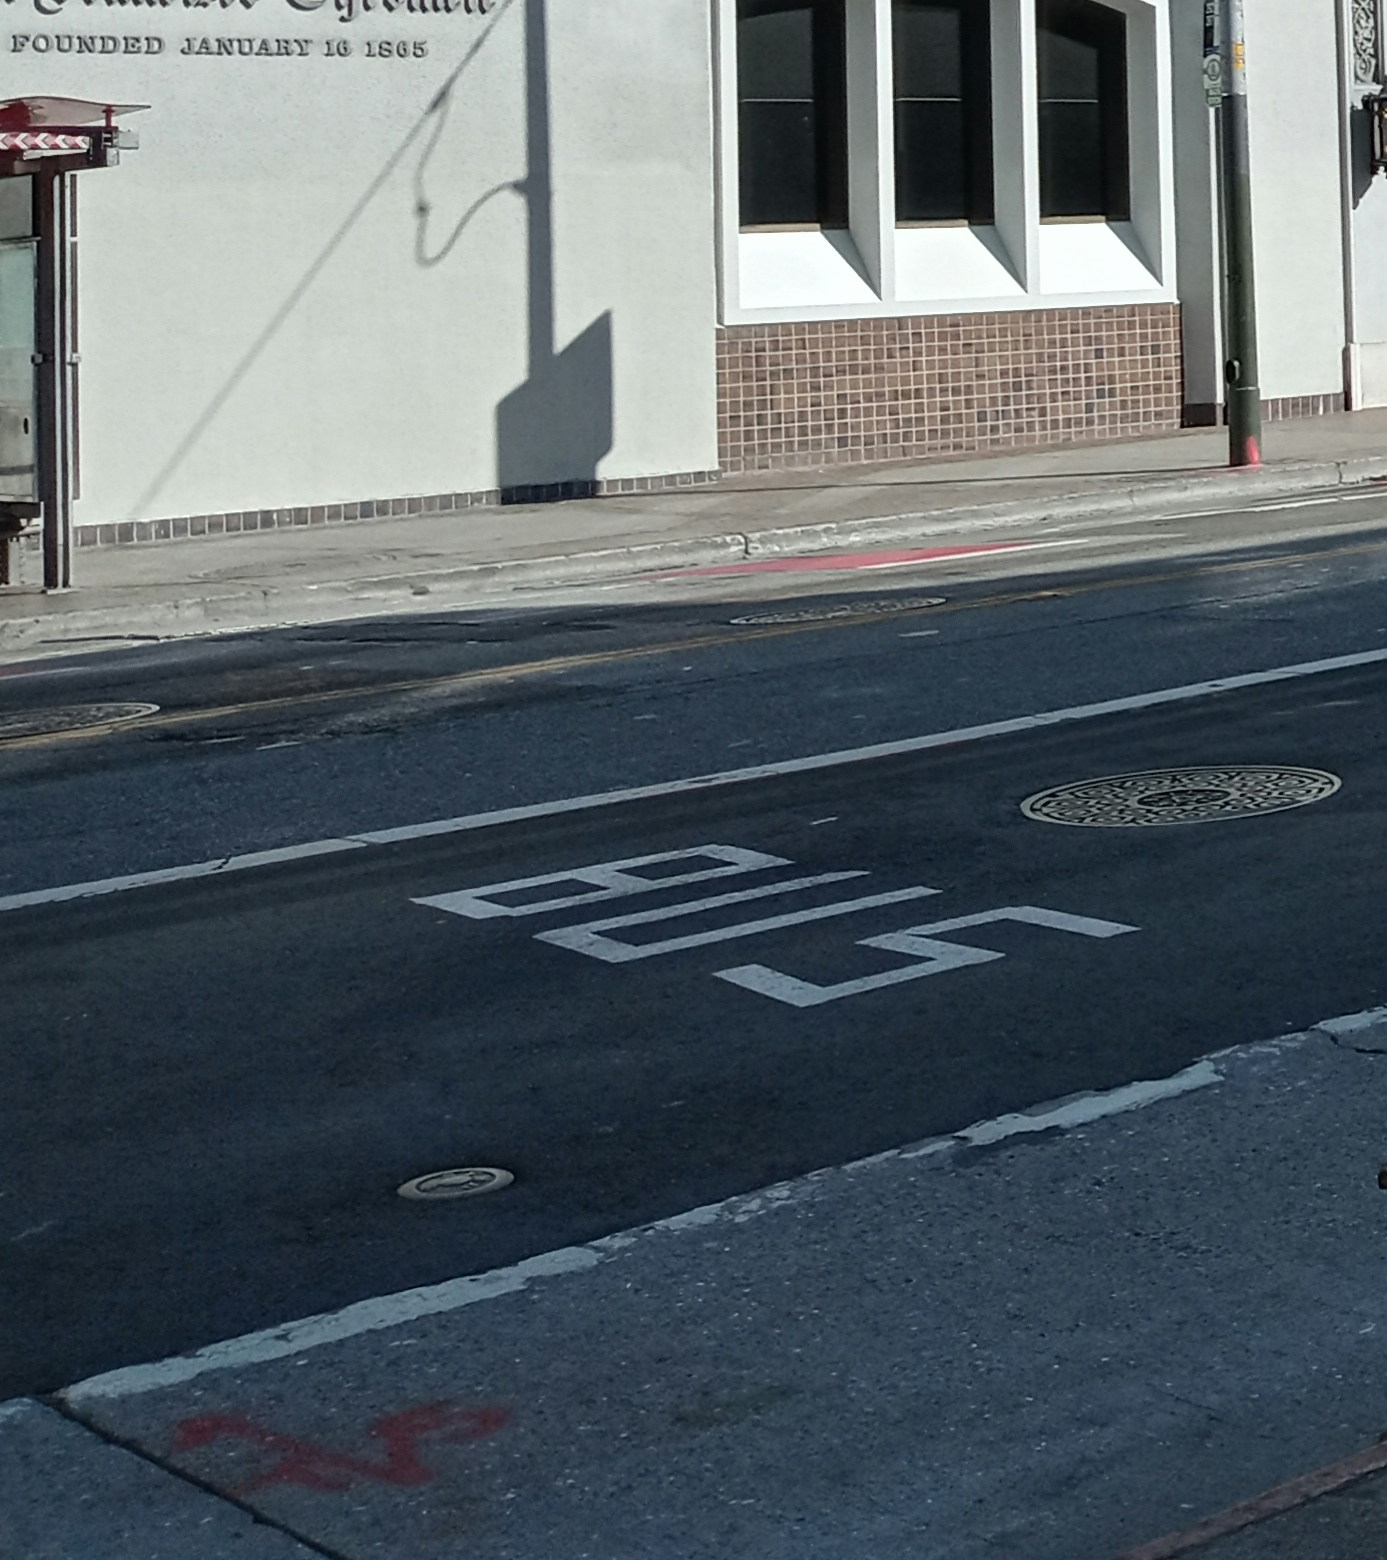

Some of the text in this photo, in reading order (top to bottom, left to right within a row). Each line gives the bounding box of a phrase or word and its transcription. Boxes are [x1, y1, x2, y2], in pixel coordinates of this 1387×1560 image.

[11, 33, 430, 59] FOUNDED JANUARY 16 1865
[410, 842, 1142, 1009] BUS
